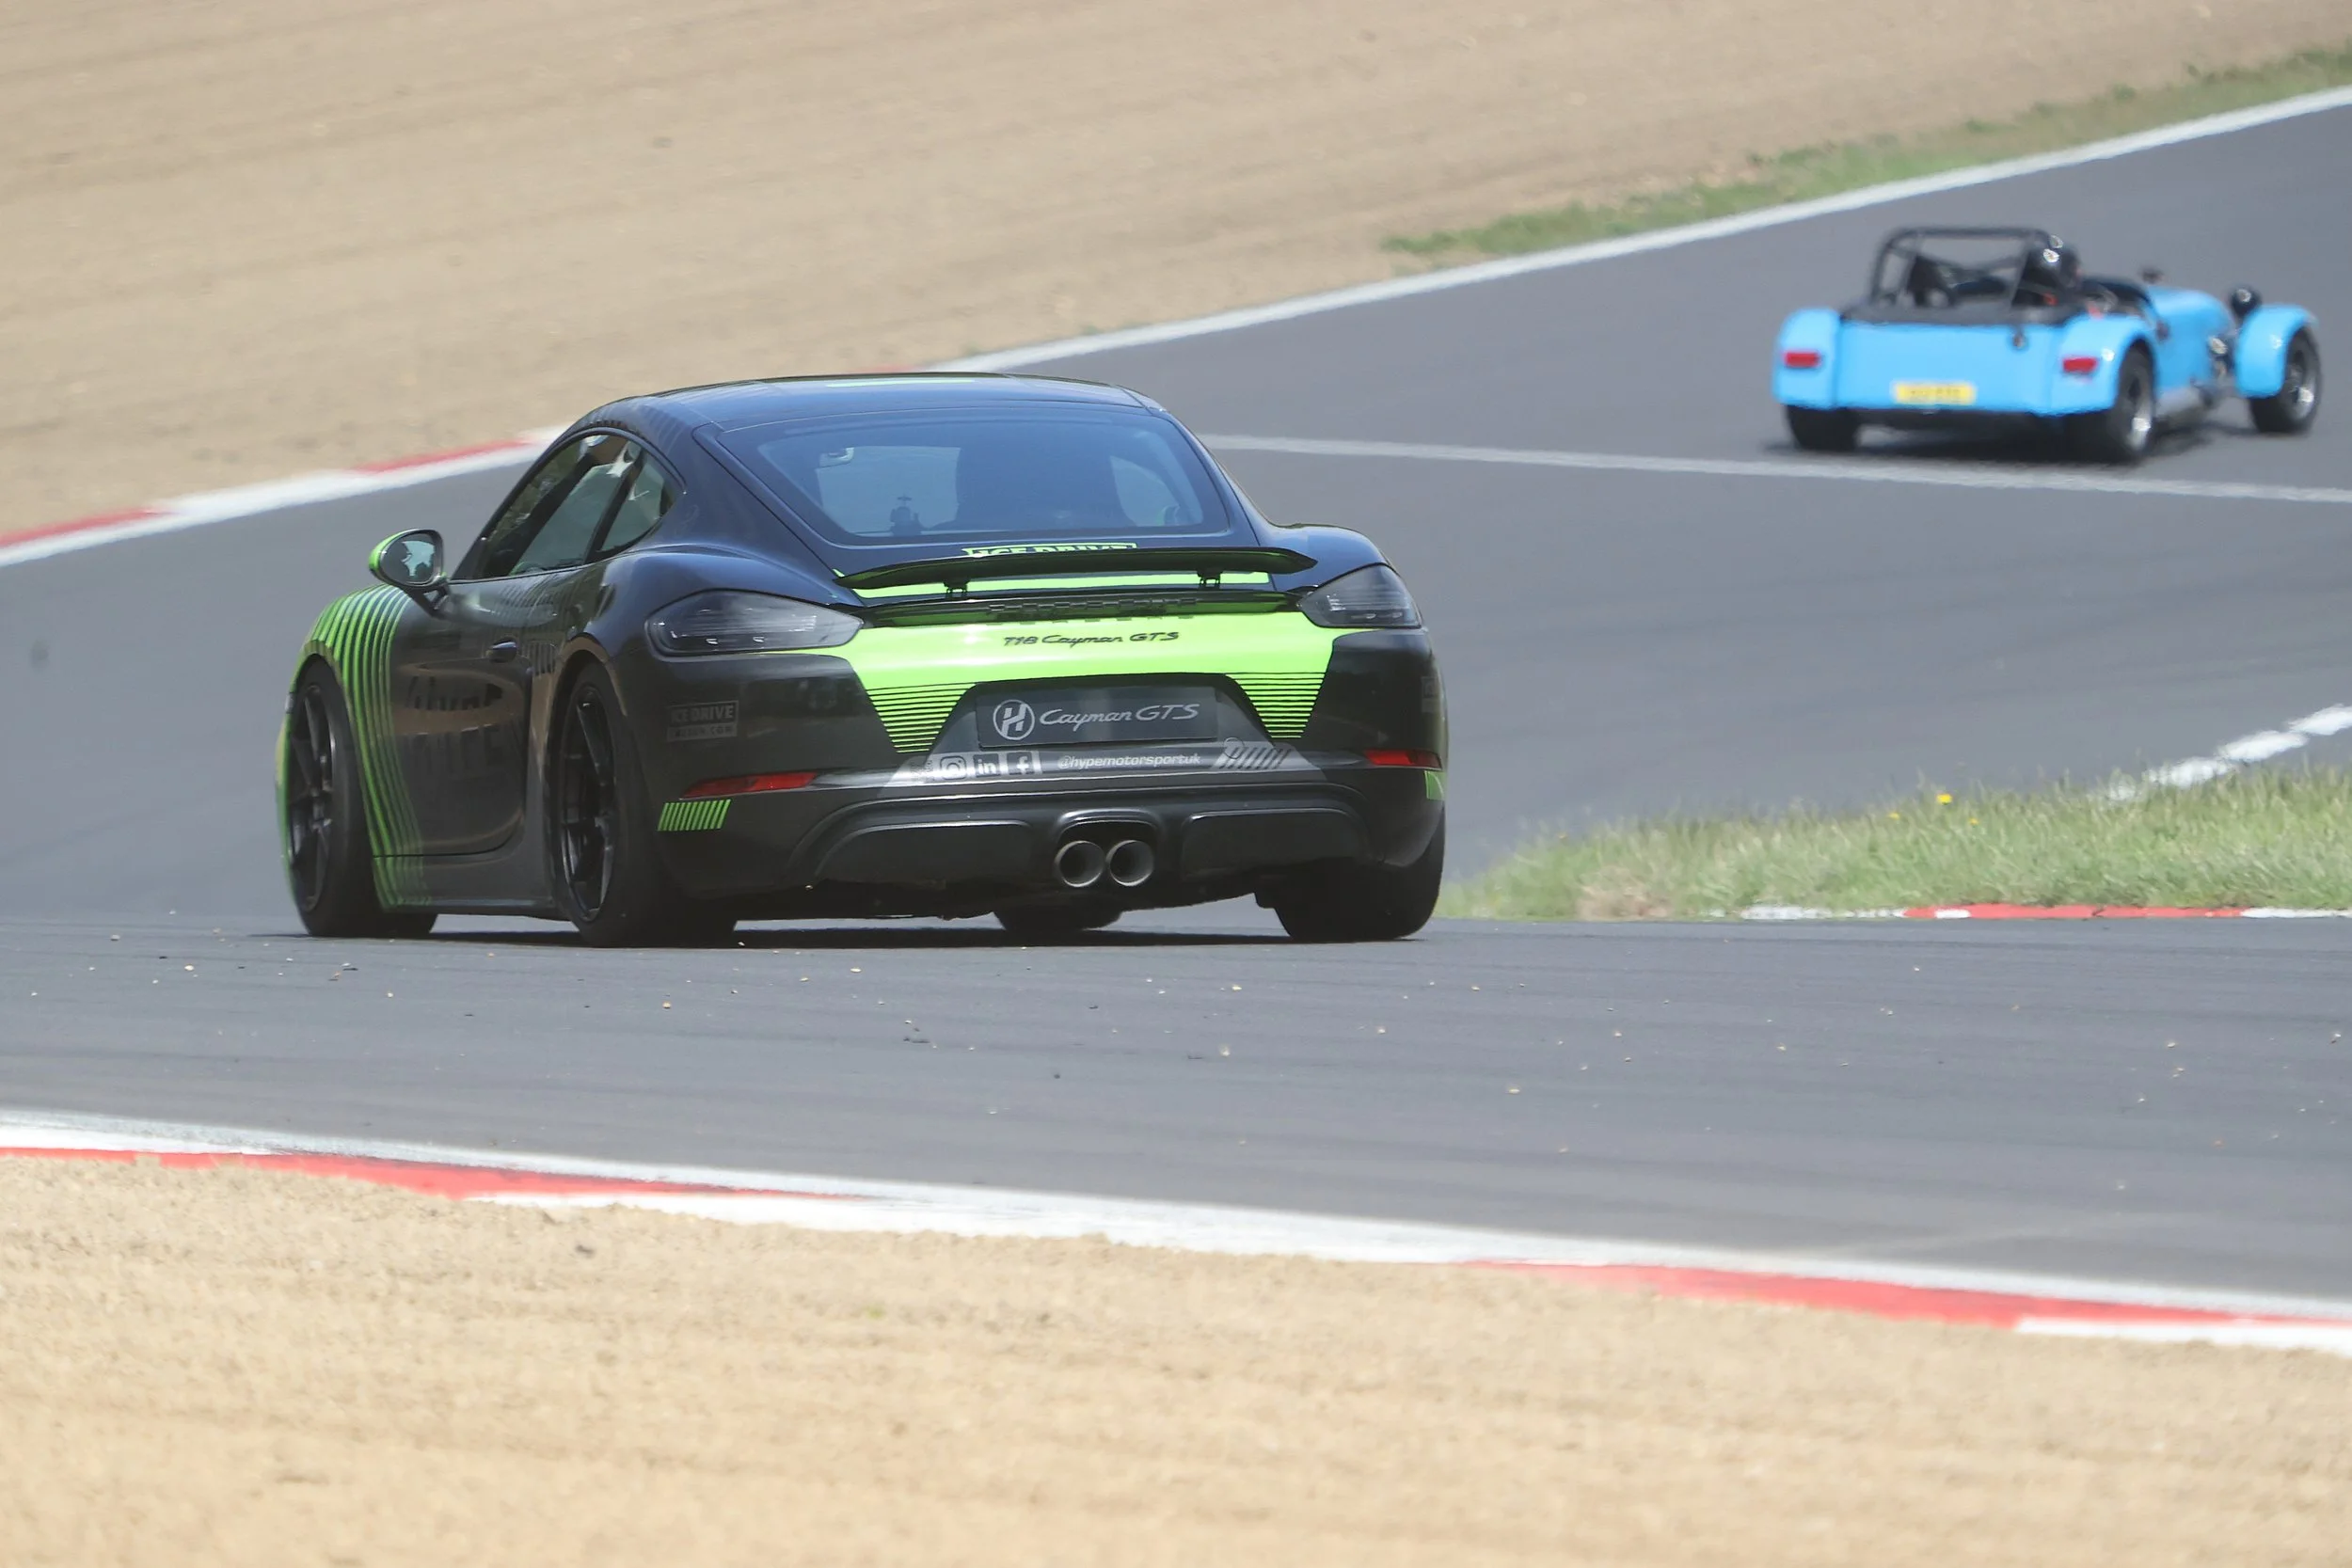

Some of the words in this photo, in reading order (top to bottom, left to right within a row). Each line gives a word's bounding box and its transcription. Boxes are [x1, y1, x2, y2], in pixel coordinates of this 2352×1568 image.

[1002, 635, 1040, 647] 718
[1041, 634, 1124, 648] Cayman
[1128, 631, 1181, 642] GTS
[1040, 708, 1133, 732] Cayman
[1135, 704, 1200, 721] GTS
[1057, 753, 1201, 769] @hypemotorsportuk
